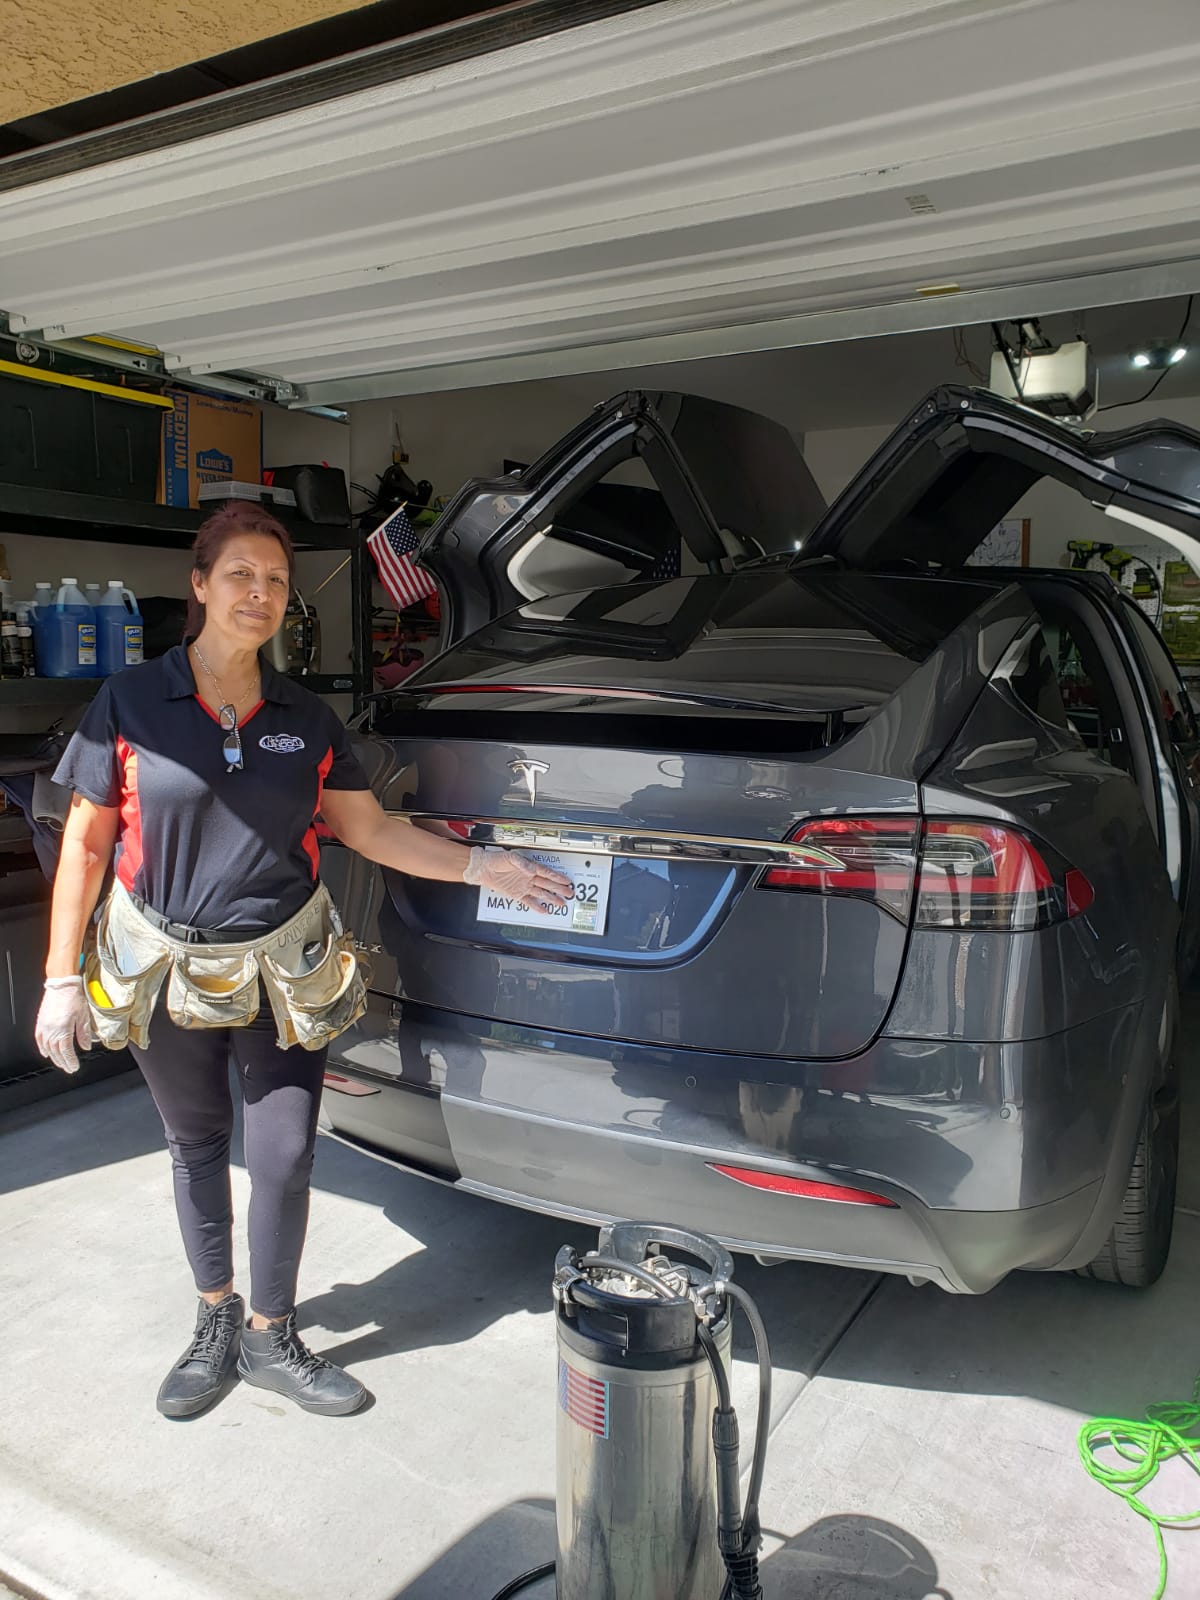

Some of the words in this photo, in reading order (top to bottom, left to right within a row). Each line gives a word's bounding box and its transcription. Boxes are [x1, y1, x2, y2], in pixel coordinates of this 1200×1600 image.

[174, 395, 187, 469] MEDIUM
[200, 455, 229, 470] LOWE'S
[532, 854, 561, 864] NEVADA
[487, 896, 514, 911] MAY
